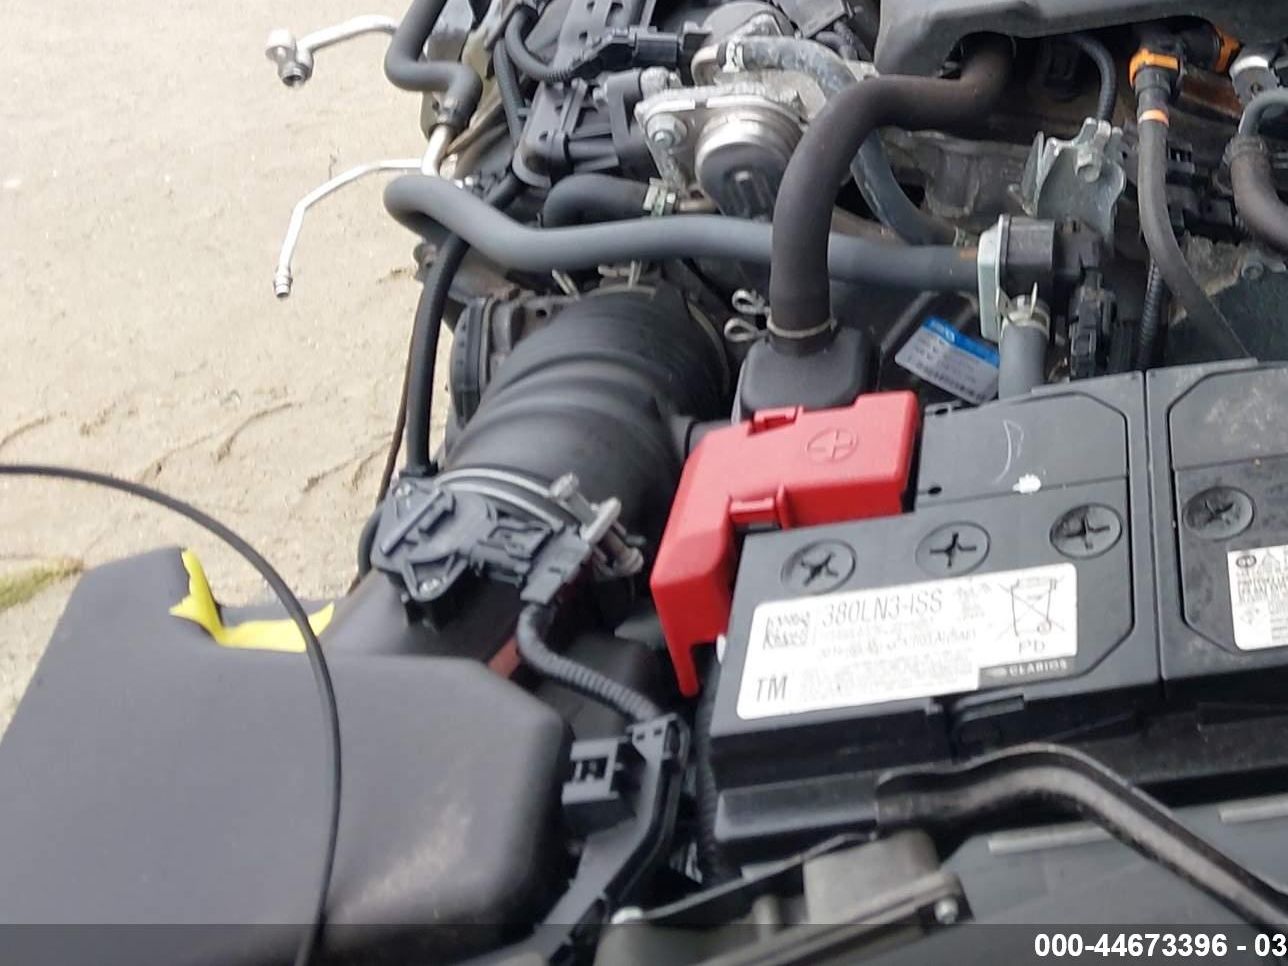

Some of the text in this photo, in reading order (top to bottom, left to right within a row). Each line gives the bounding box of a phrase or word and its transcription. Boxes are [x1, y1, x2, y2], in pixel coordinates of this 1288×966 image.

[822, 588, 942, 626] 380LN3-ISS
[1008, 657, 1068, 677] CLARIOS
[756, 675, 788, 702] TM
